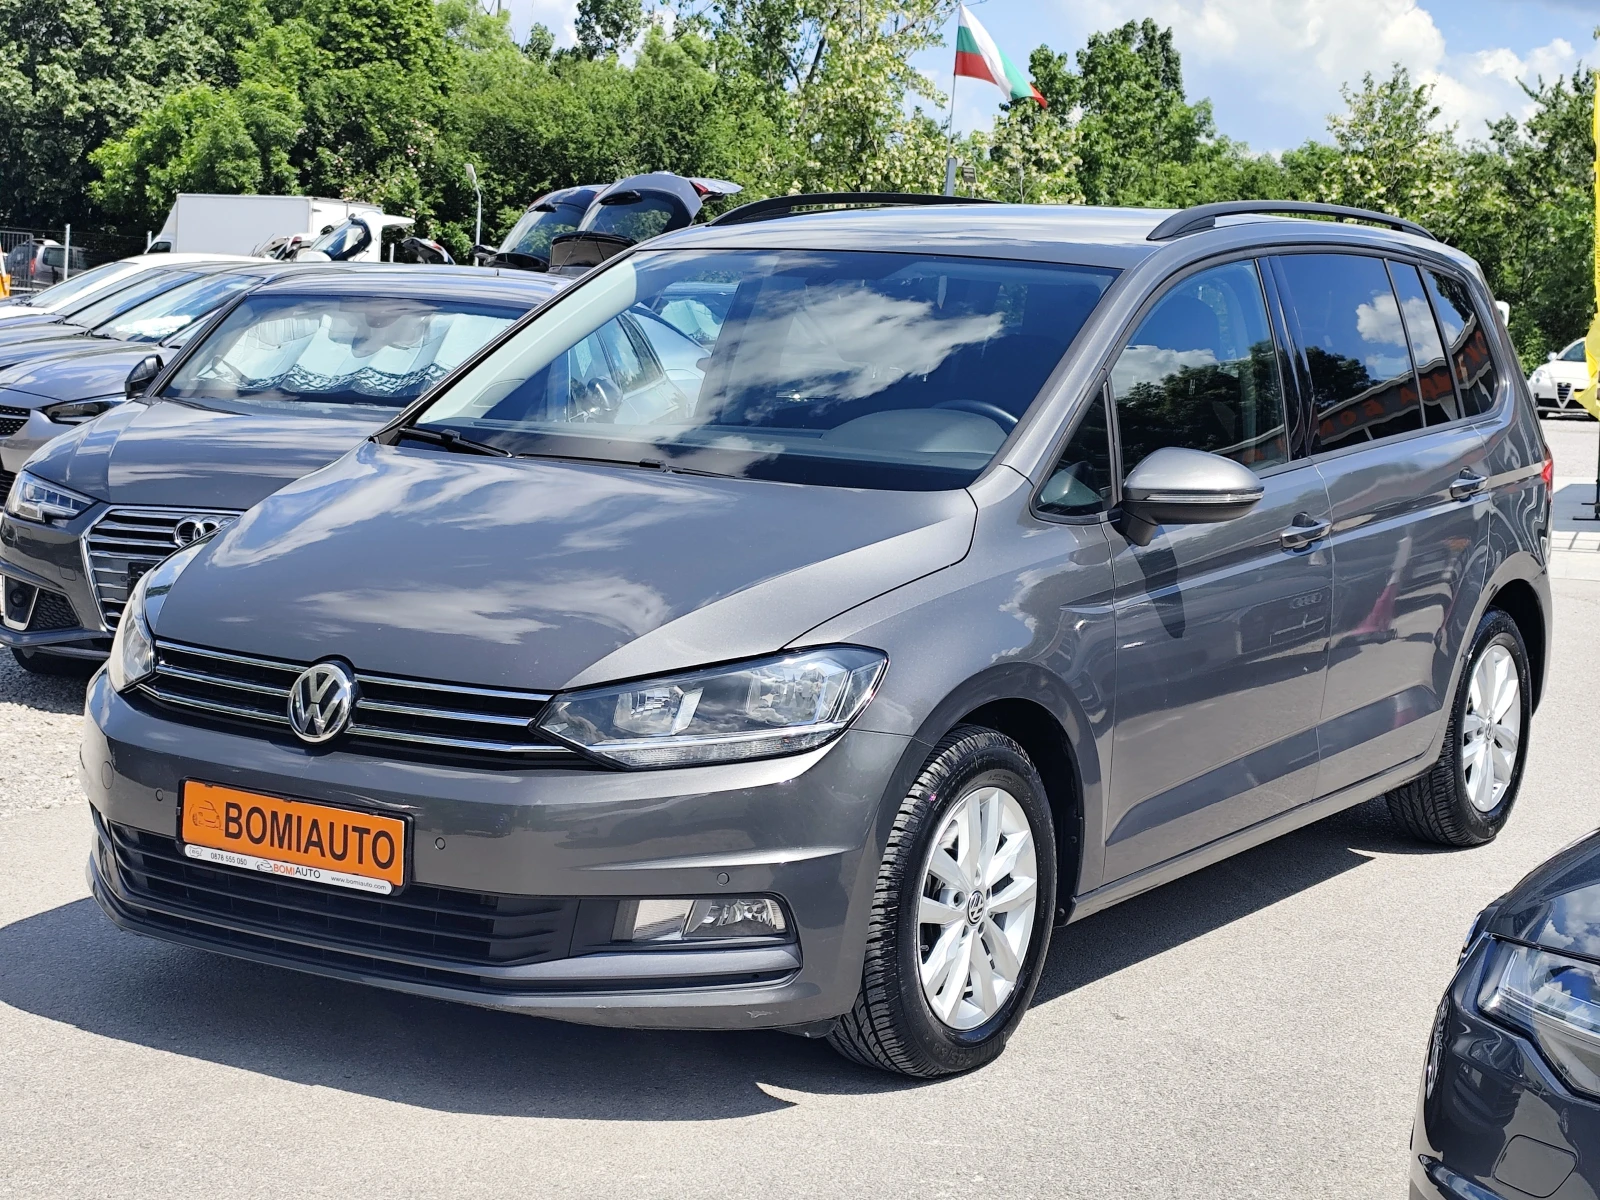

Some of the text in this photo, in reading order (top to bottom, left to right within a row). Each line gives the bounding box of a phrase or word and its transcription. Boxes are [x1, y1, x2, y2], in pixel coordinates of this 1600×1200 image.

[224, 801, 395, 870] BOMIAUTO
[210, 852, 248, 866] 0878 555 050
[273, 862, 321, 879] BOMIAUTO
[330, 874, 387, 891] www.bomiauto.com
